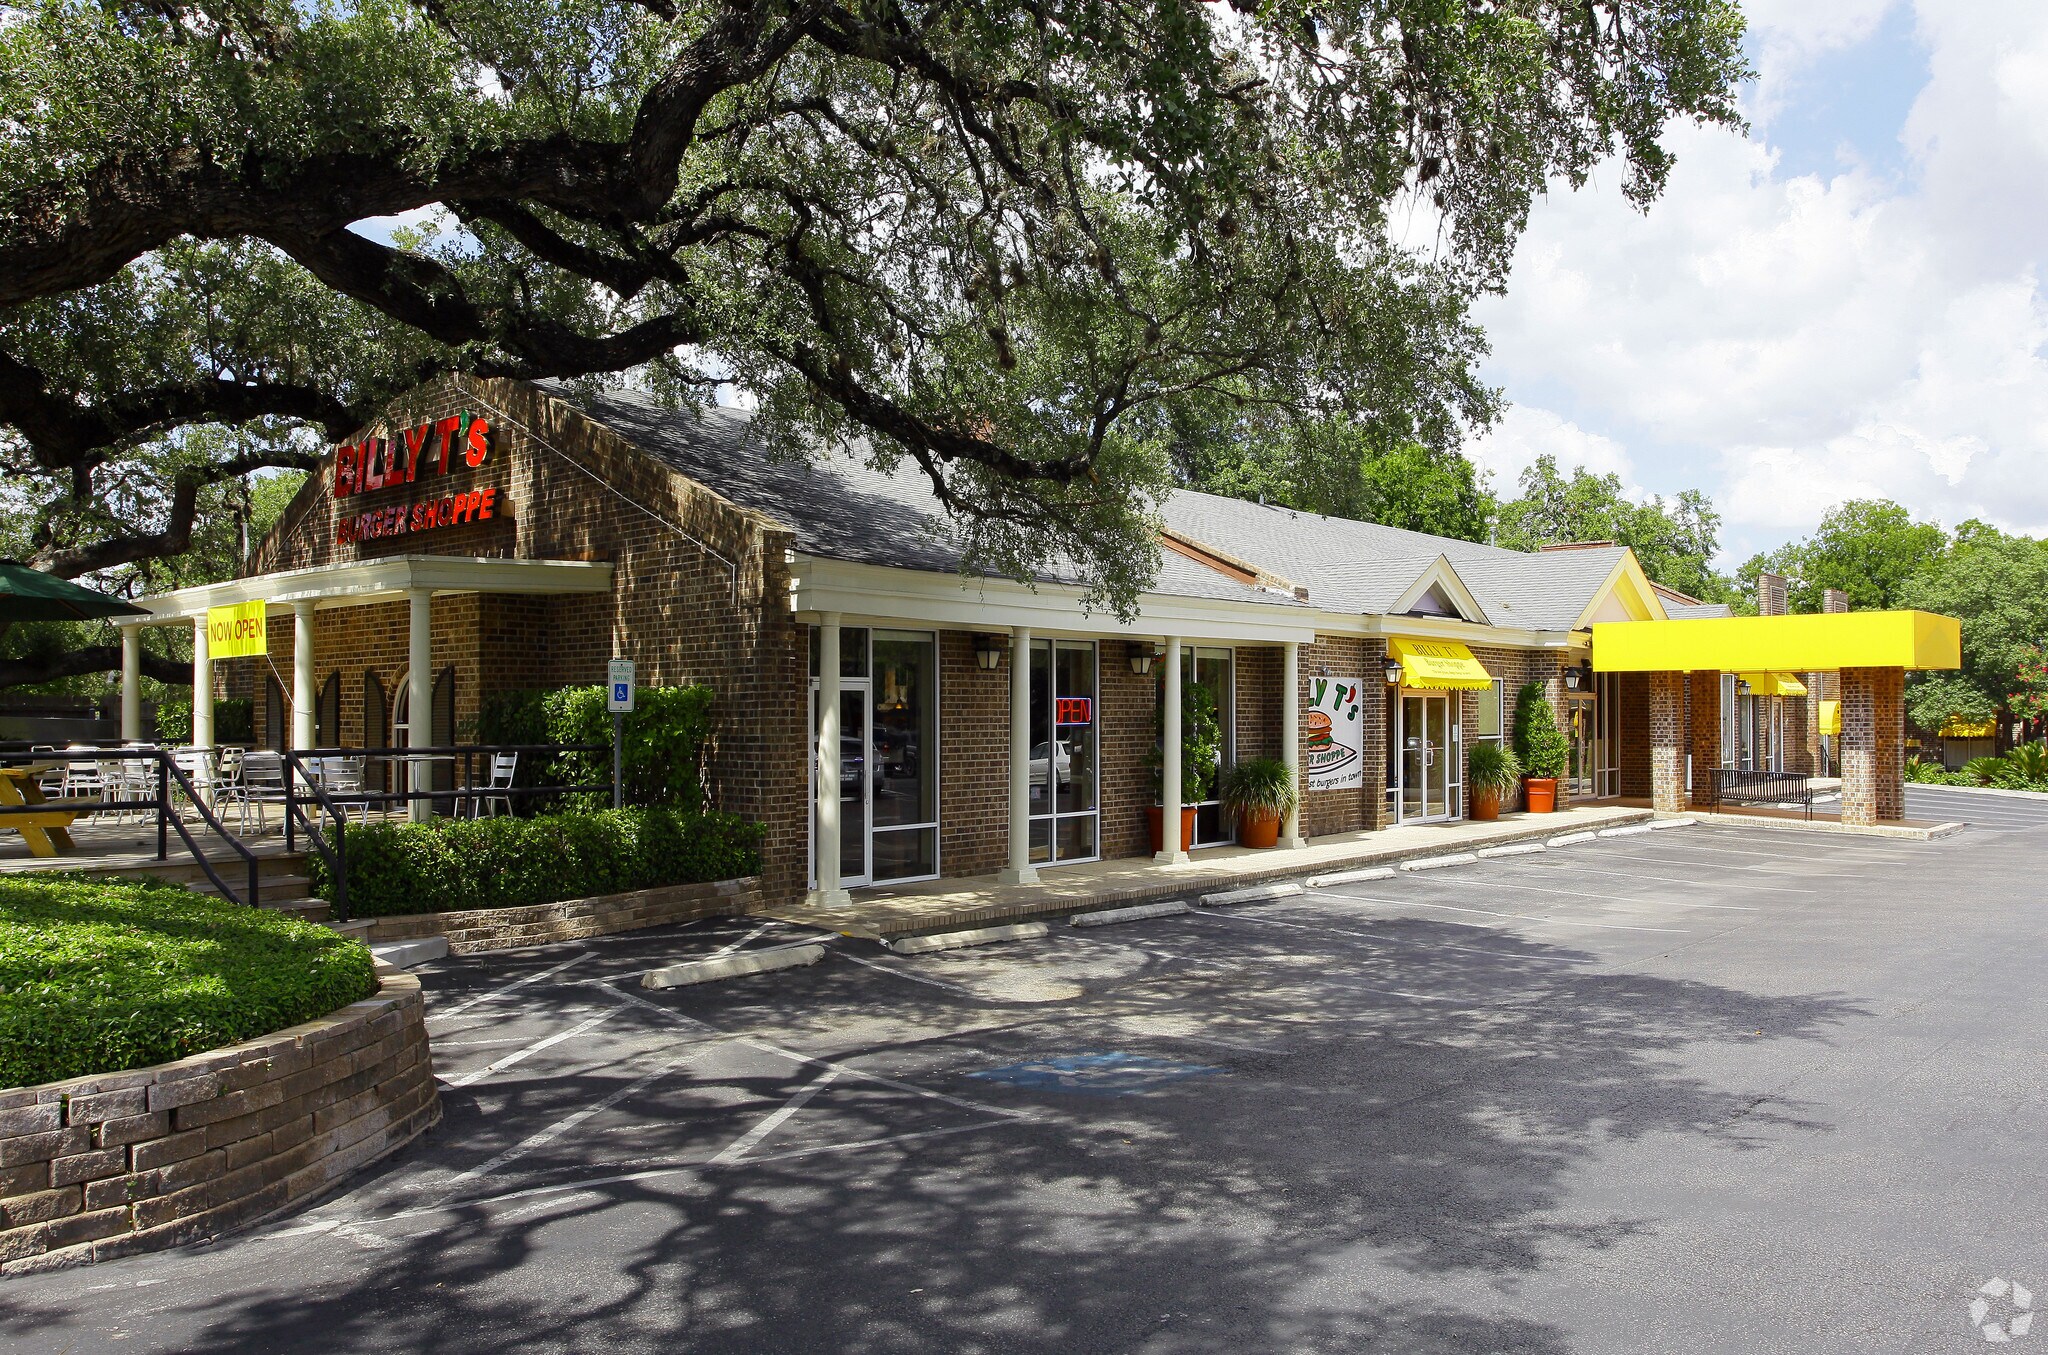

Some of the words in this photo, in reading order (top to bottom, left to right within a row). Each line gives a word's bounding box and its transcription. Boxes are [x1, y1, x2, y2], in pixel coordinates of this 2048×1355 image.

[334, 424, 429, 499] BILLY
[336, 505, 407, 545] BURGER
[410, 488, 497, 533] SHOPPE
[210, 621, 233, 643] NOW
[234, 617, 263, 641] OPEN
[1411, 643, 1443, 657] BILLY
[611, 665, 632, 674] RESERVED
[1315, 748, 1346, 764] SHOPPE
[1316, 777, 1340, 789] burgers
[1340, 774, 1347, 783] in
[1348, 770, 1362, 781] town
